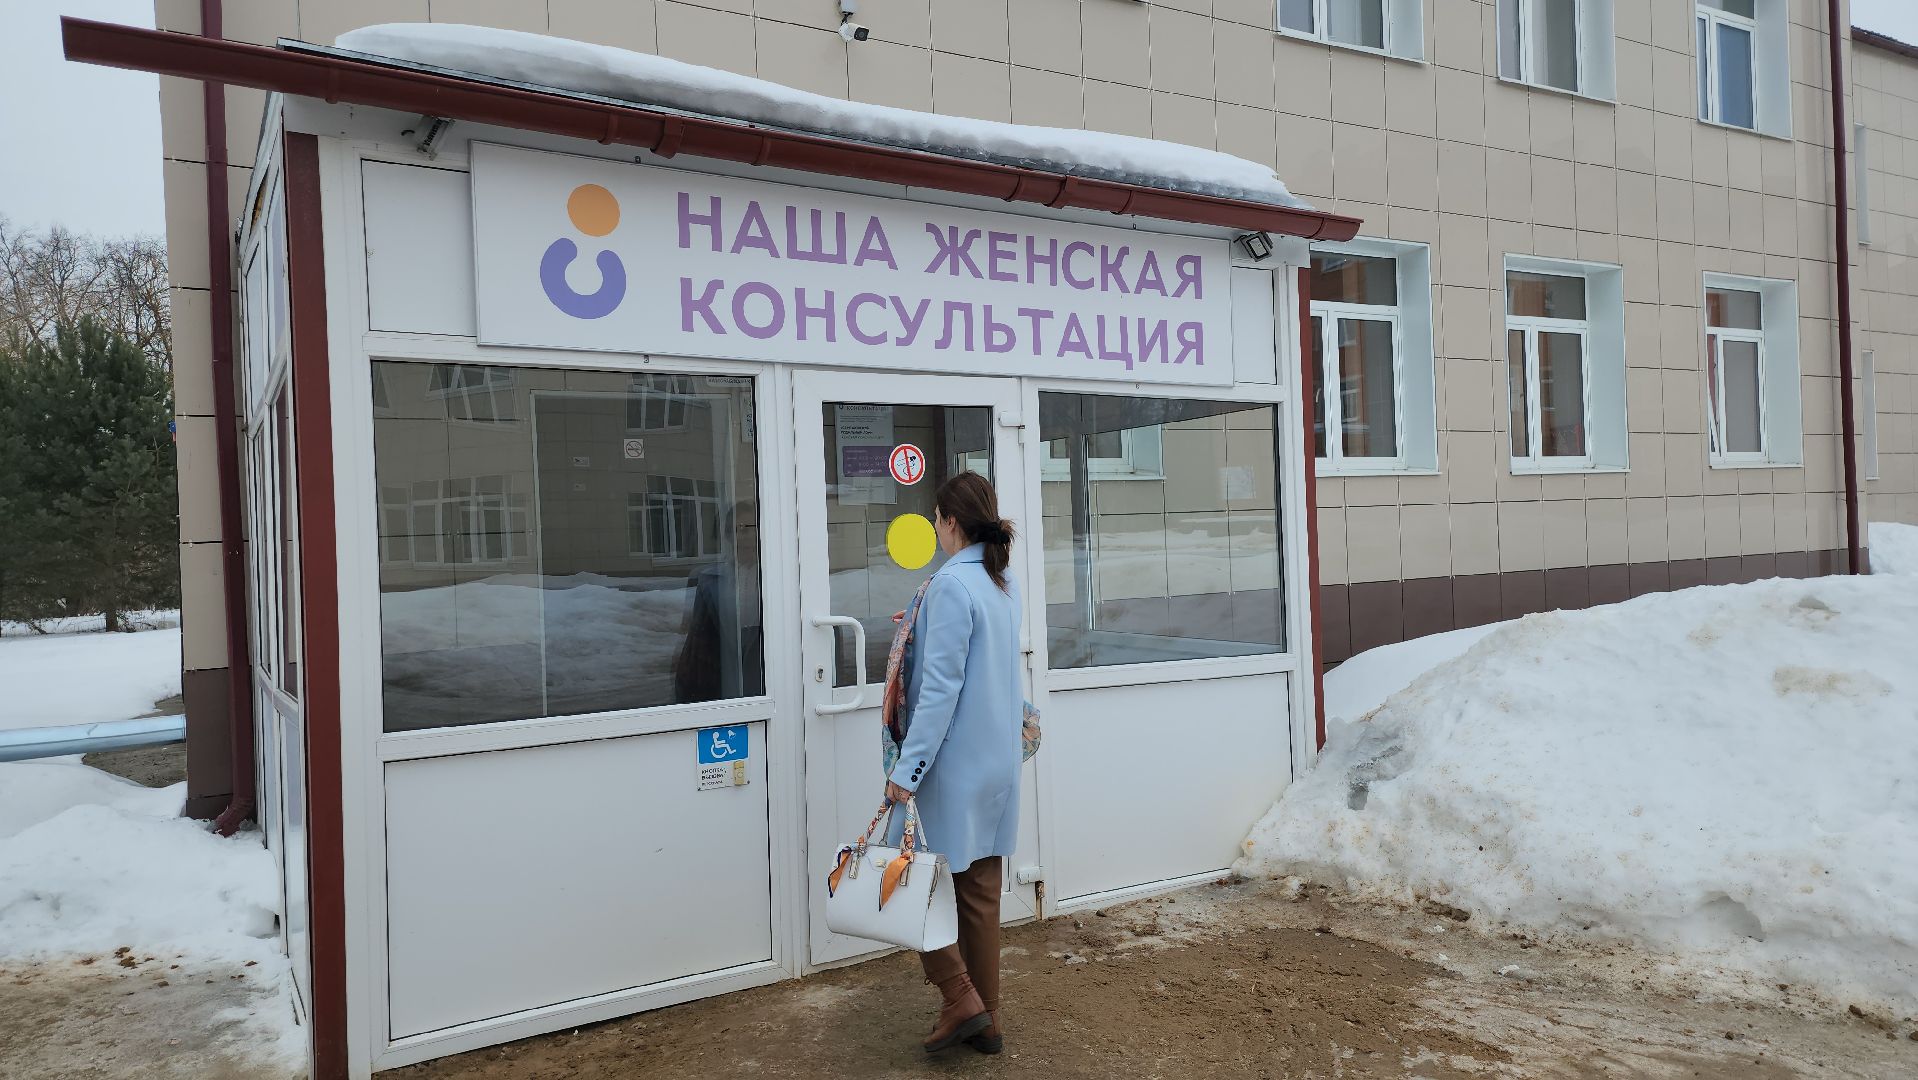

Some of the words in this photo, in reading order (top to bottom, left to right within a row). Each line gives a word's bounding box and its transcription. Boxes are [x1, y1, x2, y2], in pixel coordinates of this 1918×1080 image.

[678, 192, 897, 270] НАША
[925, 223, 1203, 300] ЖЕНСКАЯ
[681, 278, 1204, 370] КОНСУЛЬТАЦИЯ
